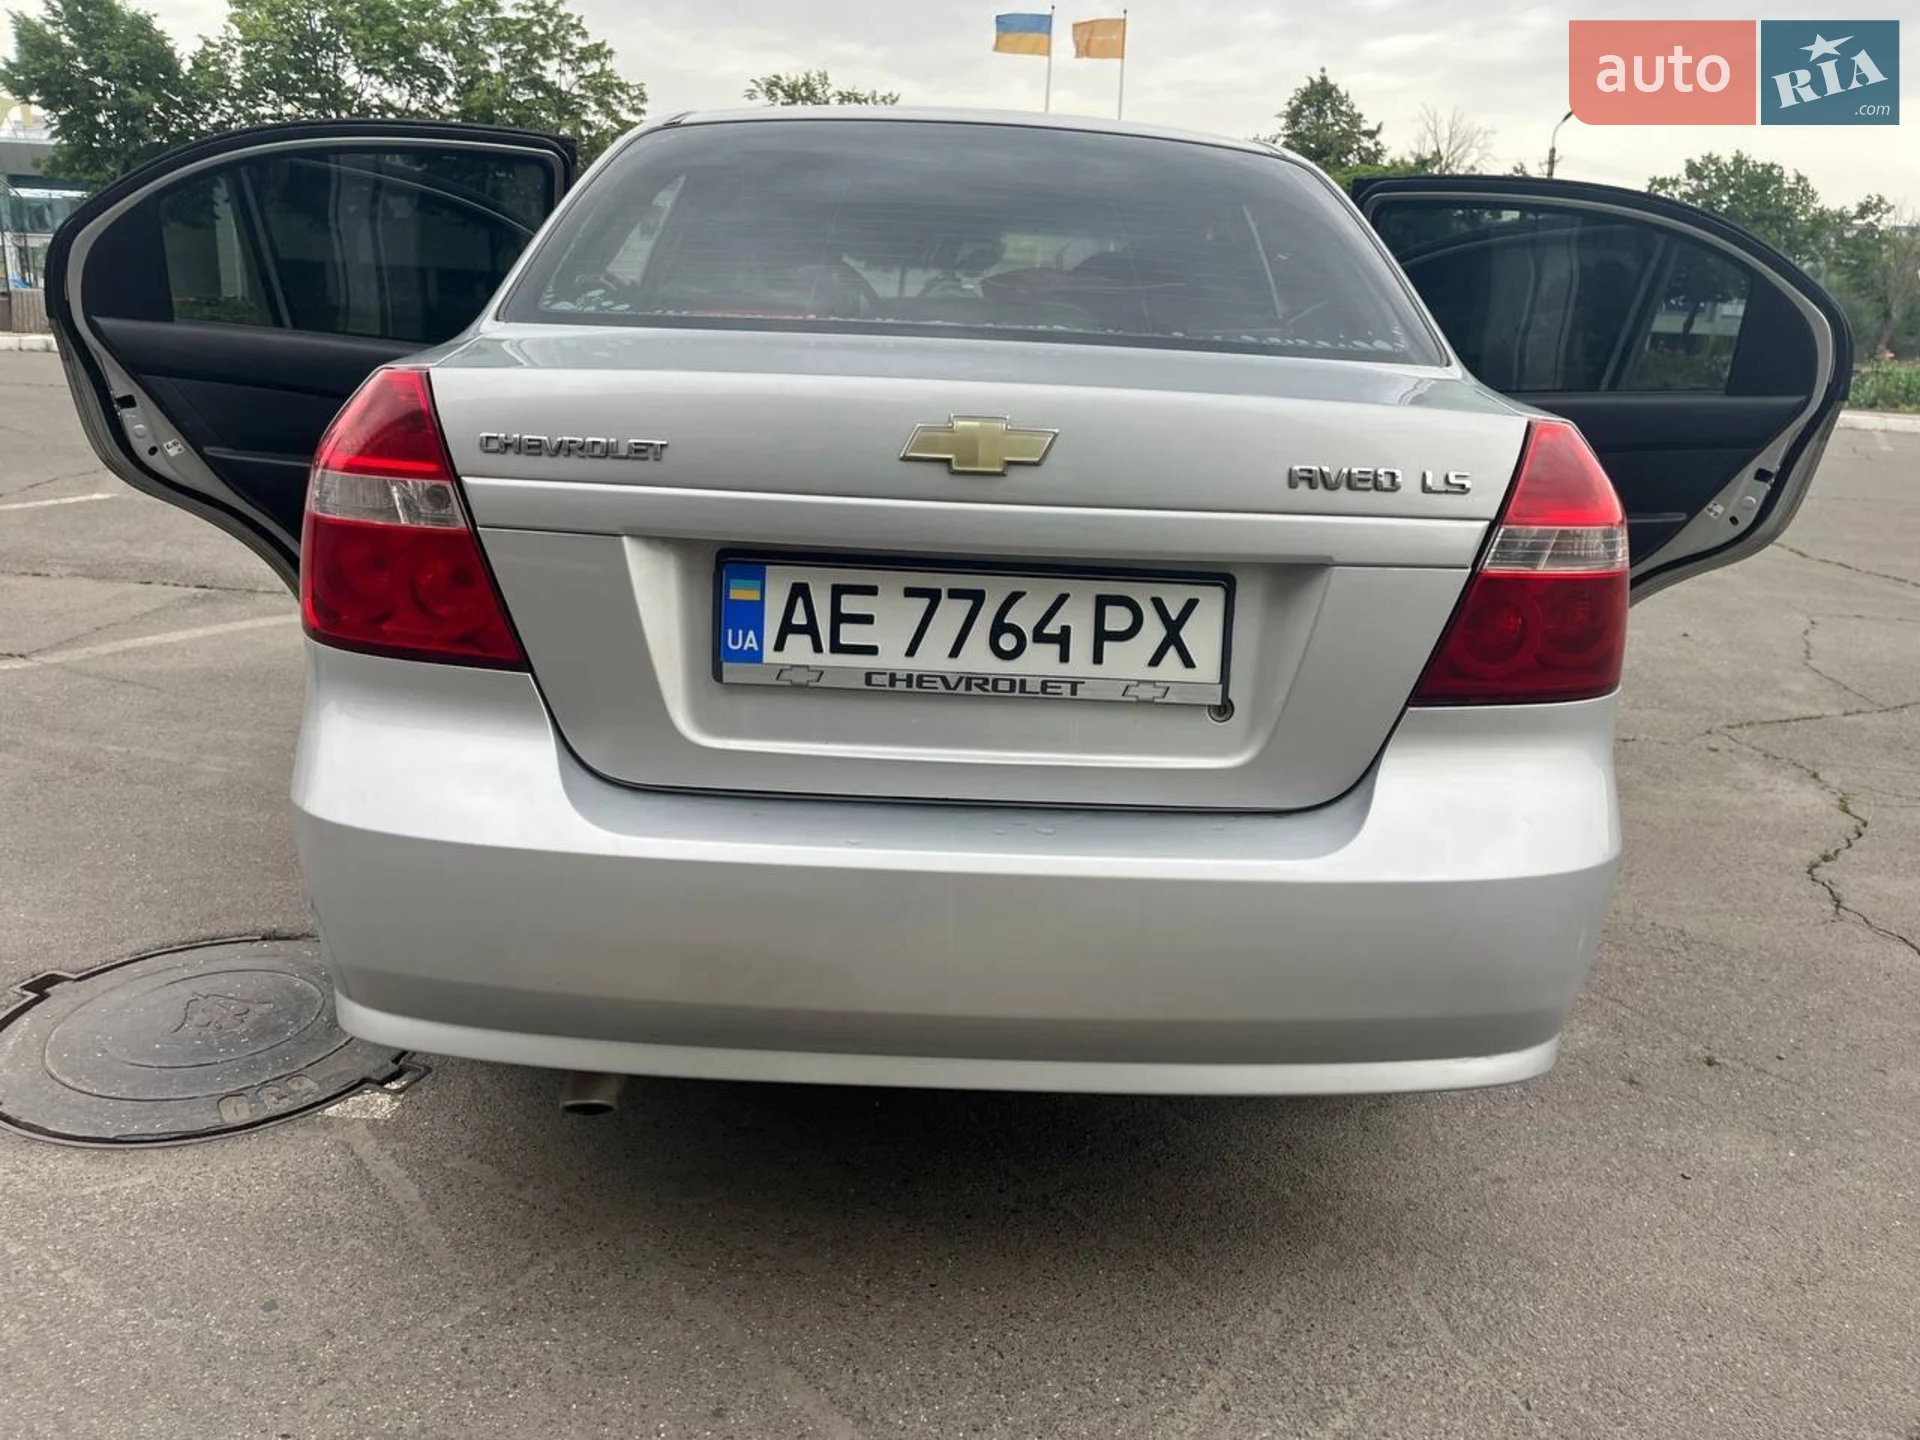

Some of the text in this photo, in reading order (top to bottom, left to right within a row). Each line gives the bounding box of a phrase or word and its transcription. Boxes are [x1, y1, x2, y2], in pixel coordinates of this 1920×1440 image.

[479, 431, 668, 462] CHEVROLET
[1288, 464, 1472, 495] AVEO LS
[727, 628, 759, 652] UA
[773, 582, 1201, 669] AE 7764 PX
[864, 671, 1085, 697] CHEVROLET
